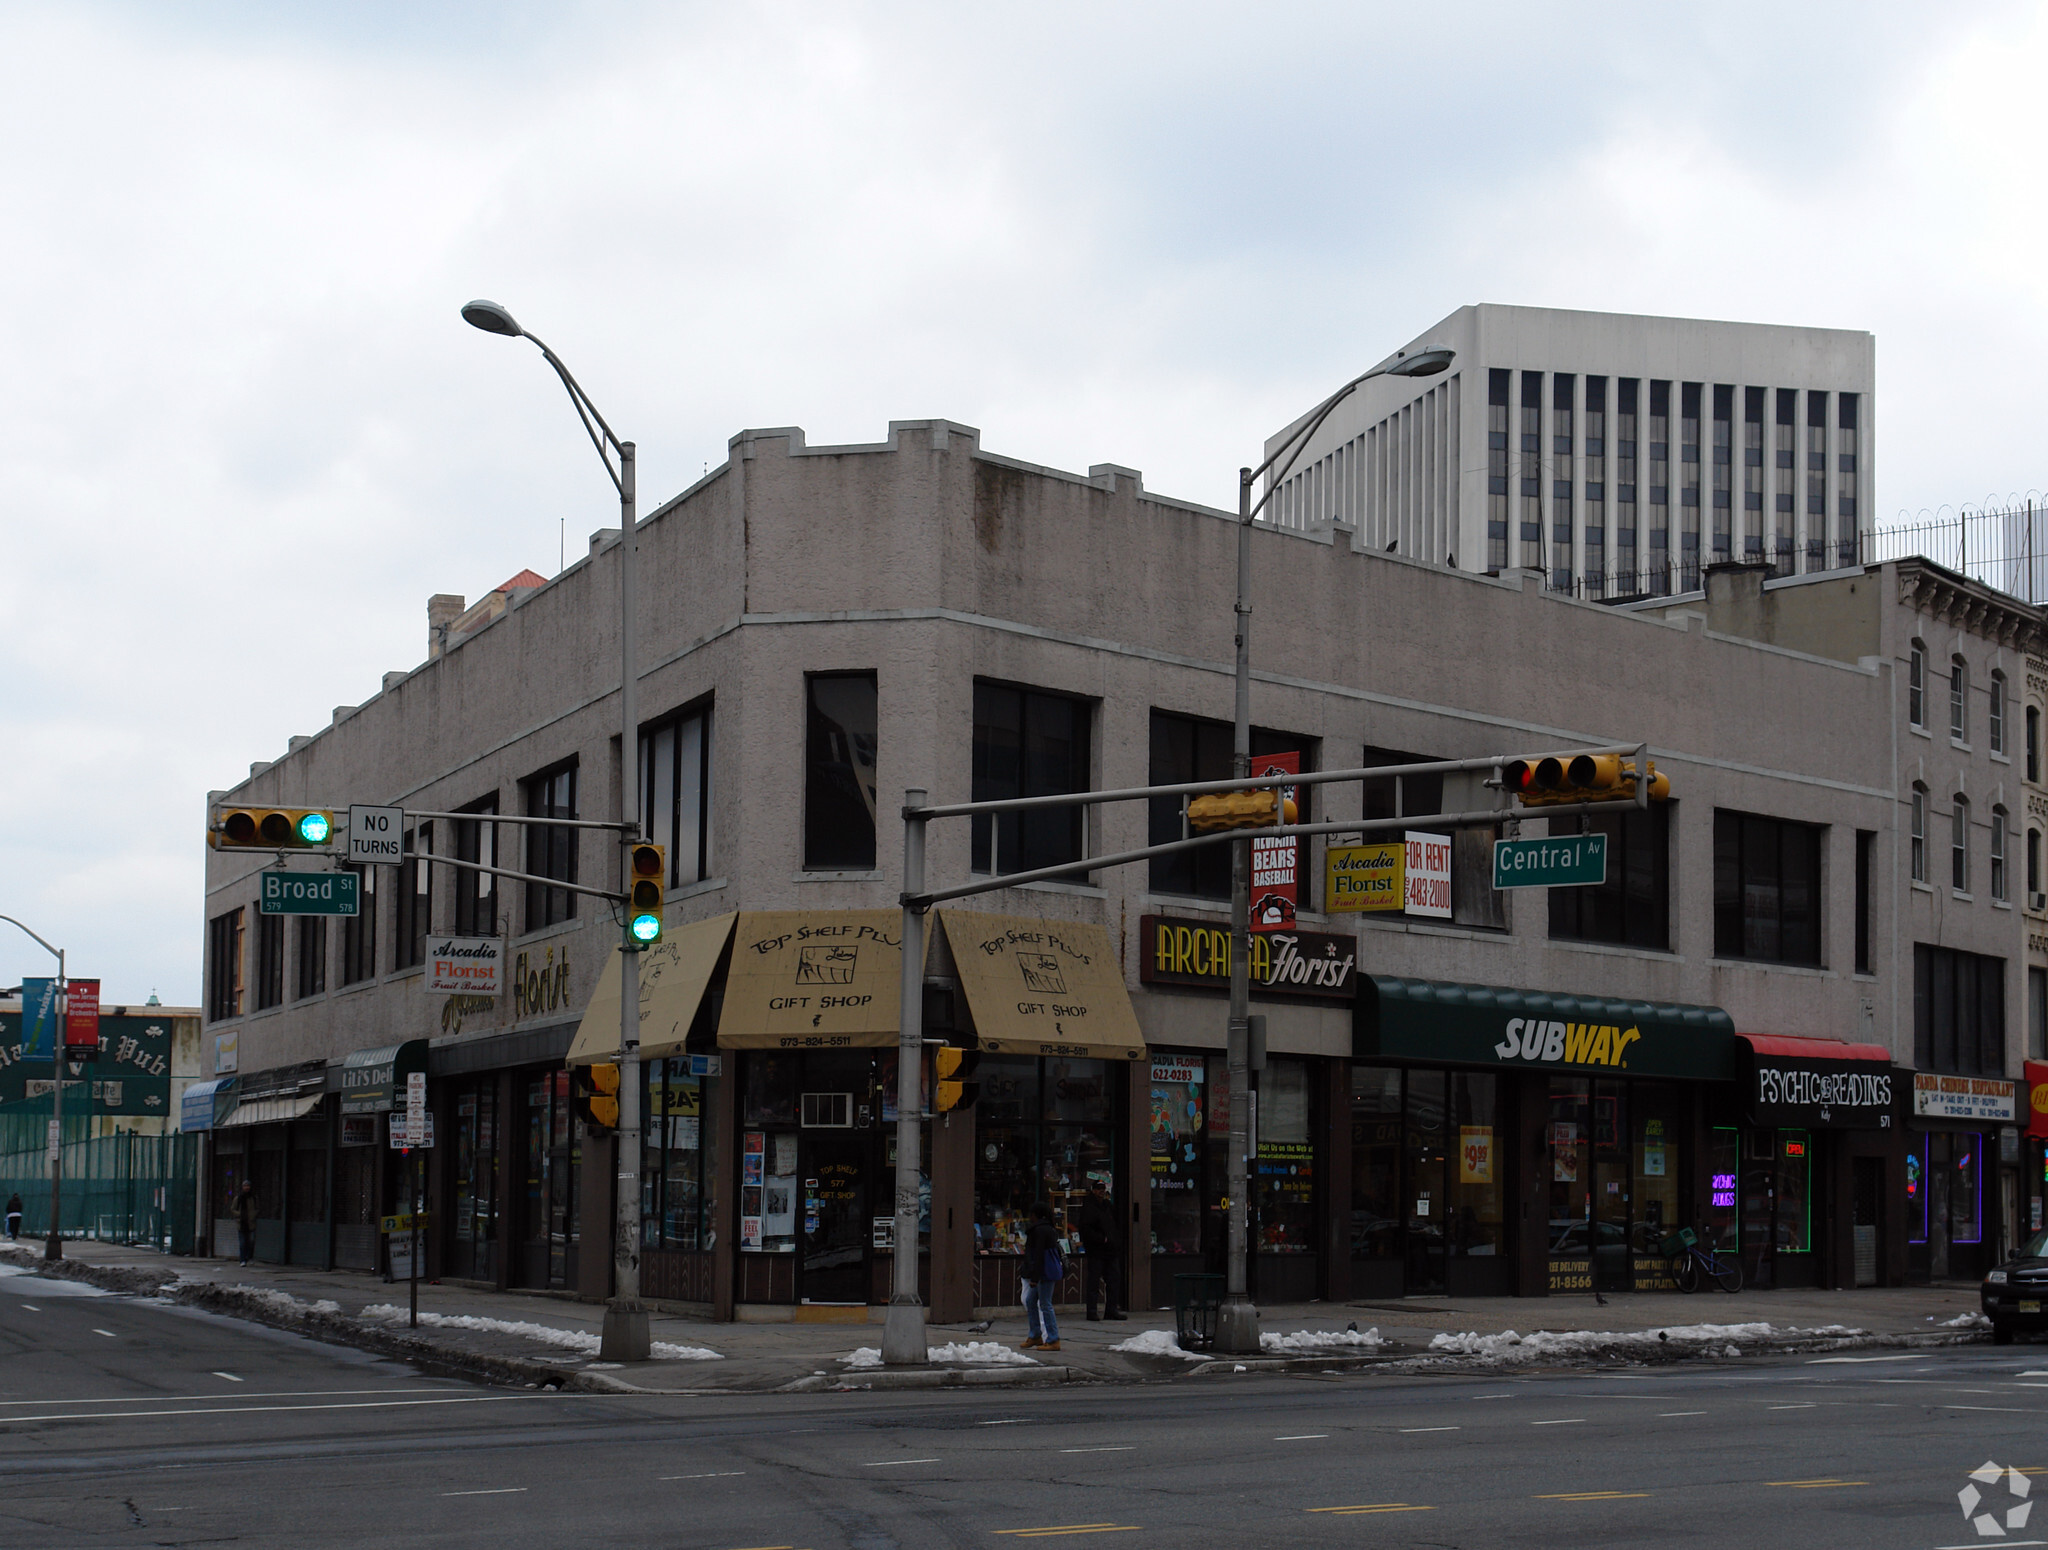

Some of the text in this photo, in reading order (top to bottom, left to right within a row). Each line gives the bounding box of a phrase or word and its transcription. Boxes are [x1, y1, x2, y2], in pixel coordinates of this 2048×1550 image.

[364, 815, 389, 832] NO
[353, 839, 399, 855] TURNS
[1253, 849, 1296, 871] BEARS
[1333, 851, 1395, 871] Arcadia
[1405, 840, 1450, 873] FOR RENT
[1500, 841, 1601, 871] Central Av
[1253, 869, 1295, 887] BASEBALL
[1334, 874, 1393, 893] Florist
[266, 876, 353, 900] Broad St
[266, 902, 282, 911] 579
[339, 904, 353, 913] 578
[1332, 895, 1395, 907] Fruit Basket
[750, 934, 792, 954] TOP
[797, 925, 853, 941] SHELF
[979, 936, 1005, 956] TOP
[1006, 930, 1044, 945] SHELF
[1048, 935, 1092, 965] PLUS
[433, 941, 497, 958] Arcadia
[1260, 934, 1354, 988] Florist
[434, 961, 495, 979] Florist
[431, 980, 497, 992] Fruit Basket
[514, 945, 570, 1020] Florist
[769, 995, 872, 1010] GIFT SHOP
[1017, 1002, 1087, 1018] GIFT SHOP
[780, 1037, 851, 1048] 973-824-5511
[1040, 1045, 1088, 1056] 973-824-5511
[1494, 1017, 1641, 1067] SUBWAY
[114, 1035, 166, 1076] Pub
[1176, 1057, 1205, 1069] FLORIST
[372, 1064, 393, 1085] Deli
[1153, 1068, 1193, 1082] 622-0283
[1759, 1068, 1892, 1107] PSYCHIC READINGS
[1915, 1075, 2014, 1098] PANDA CHINESE RESTAURANT
[345, 1118, 375, 1132] ATM
[830, 1179, 846, 1188] 577
[1159, 1179, 1185, 1190] Balloons
[1560, 1261, 1590, 1273] DELIVERY
[1634, 1259, 1650, 1270] GIANT
